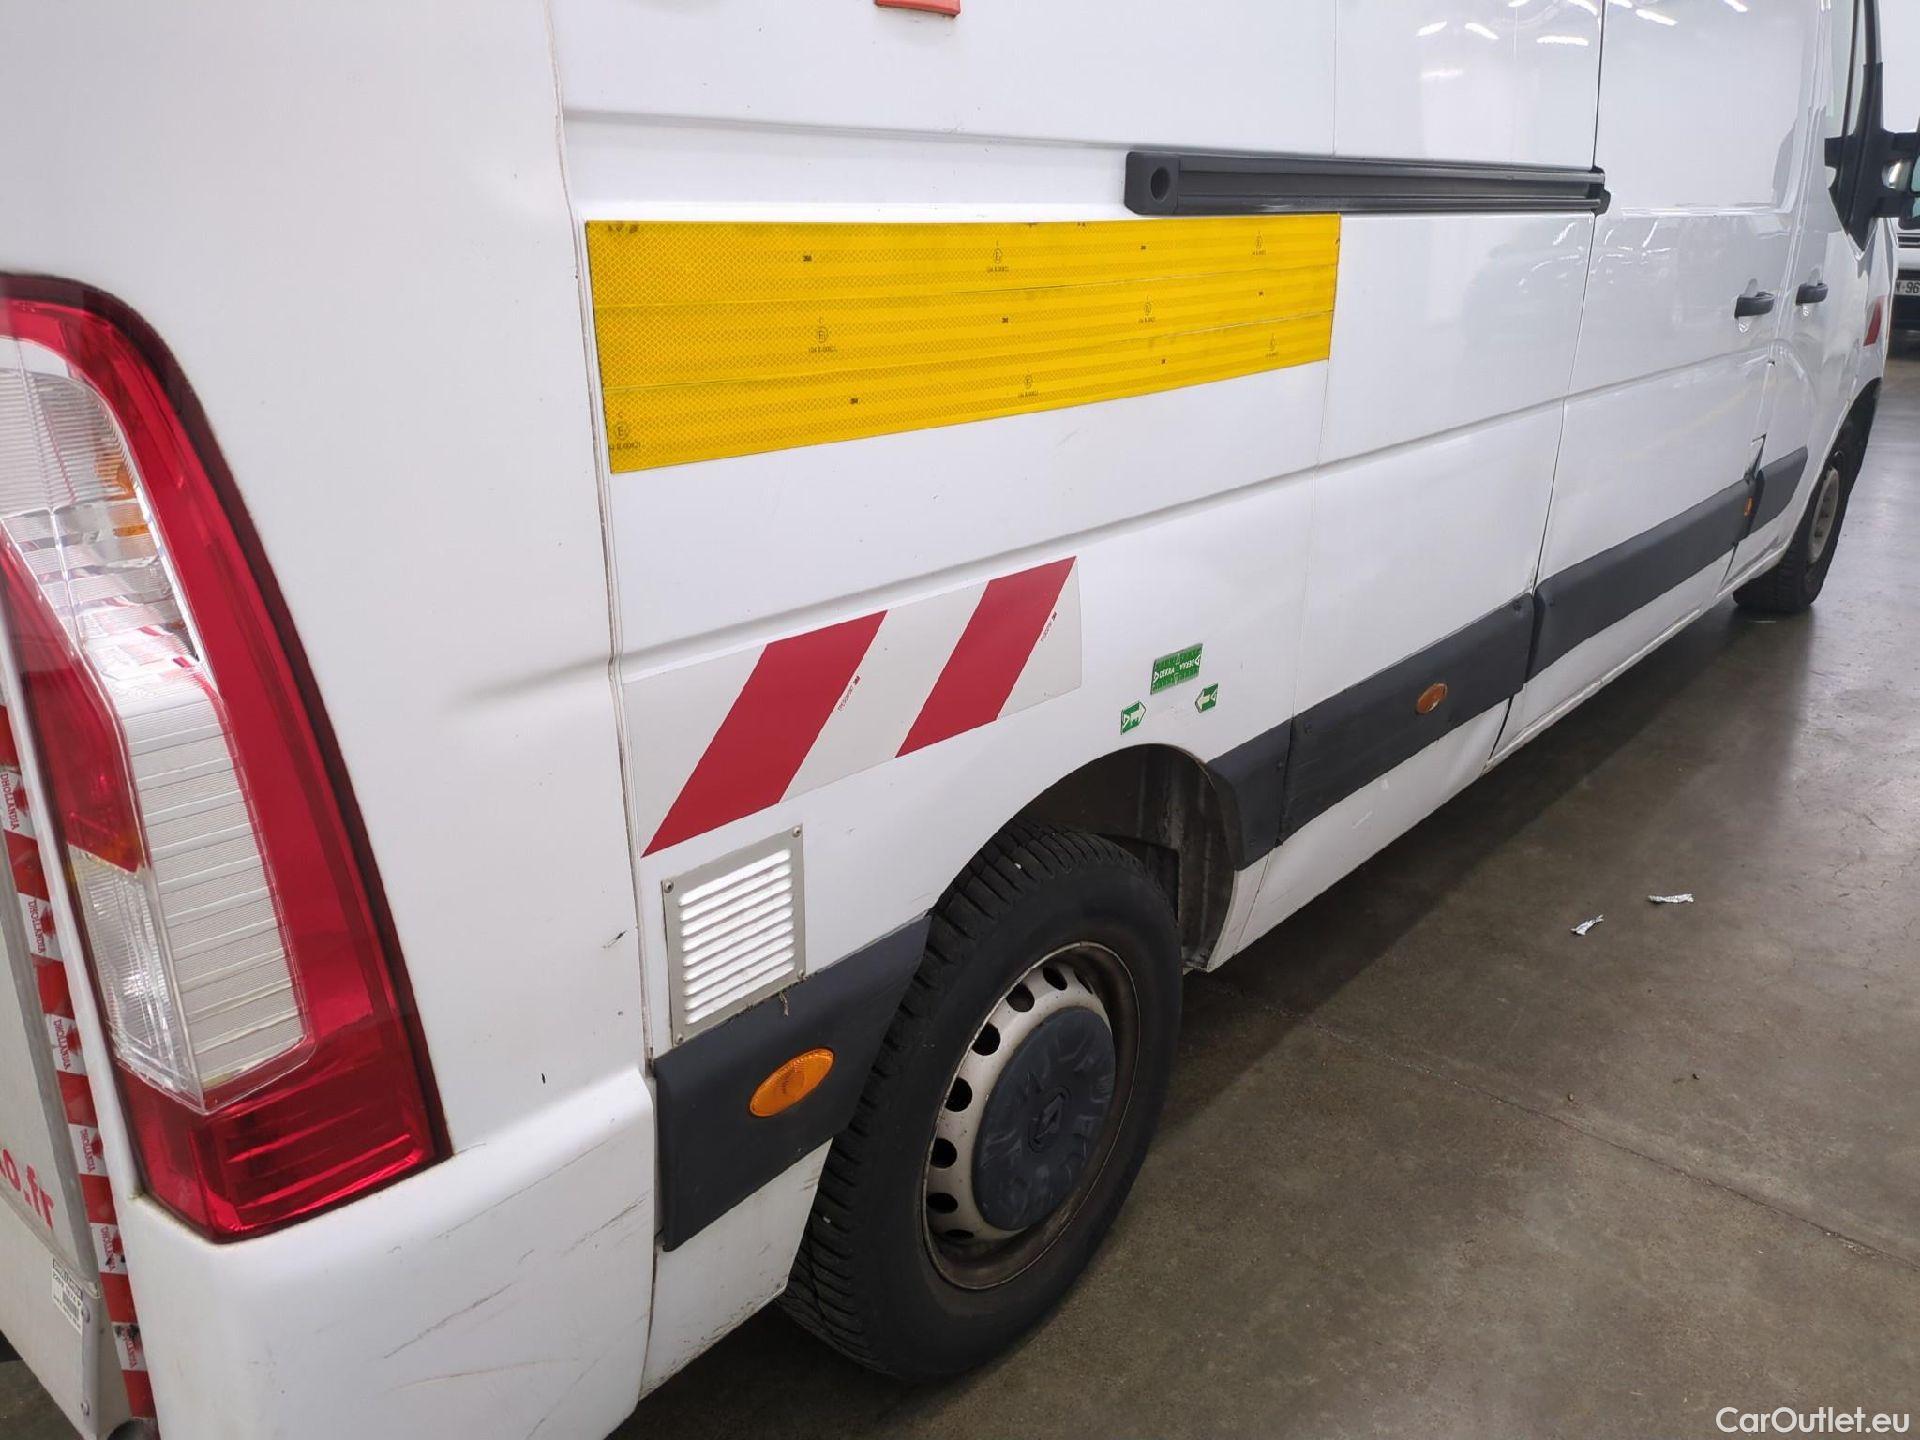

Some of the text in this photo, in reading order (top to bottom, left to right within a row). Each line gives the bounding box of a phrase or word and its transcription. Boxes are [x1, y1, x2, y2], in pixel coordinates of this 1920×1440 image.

[0, 773, 20, 831] DHOLLANDIA
[28, 899, 47, 954] DHOLLANDIA
[53, 1019, 72, 1071] DHOLLANDIA
[0, 1148, 54, 1230] o.fr
